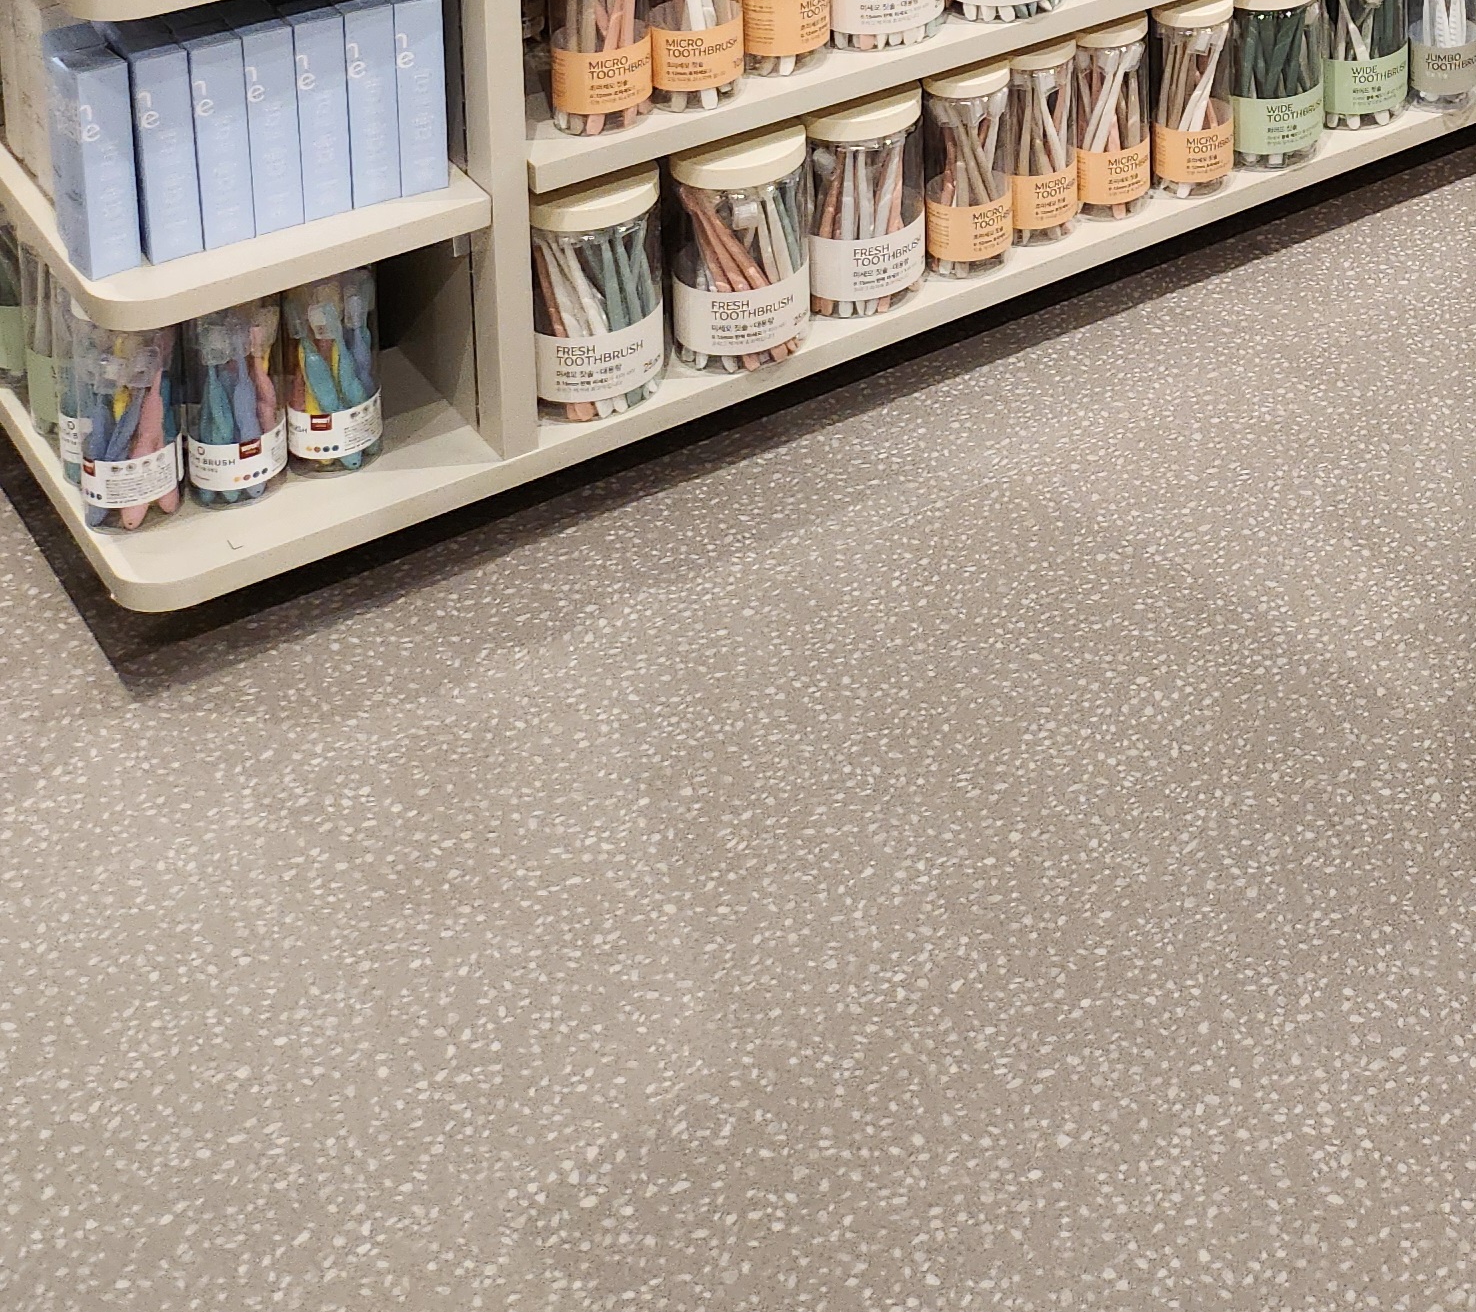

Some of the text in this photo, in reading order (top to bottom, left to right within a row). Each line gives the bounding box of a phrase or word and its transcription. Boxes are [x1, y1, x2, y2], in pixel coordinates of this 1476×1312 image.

[666, 38, 704, 48] MICRO
[666, 36, 738, 58] TOOTHBRUSH
[589, 56, 629, 70] MICRO
[1425, 53, 1461, 63] JUMBO
[1351, 66, 1378, 76] WIDE
[1266, 104, 1293, 115] WIDE
[1186, 135, 1219, 146] MICRO
[1108, 153, 1139, 166] MICRO
[1035, 177, 1067, 191] MICRO
[972, 205, 1005, 221] MICRO
[853, 244, 890, 256] FRESH
[711, 300, 751, 311] FRESH
[711, 295, 794, 320] TOOTHBRUSH
[556, 345, 596, 357] FRESH
[556, 340, 644, 366] TOOTHBRUSH
